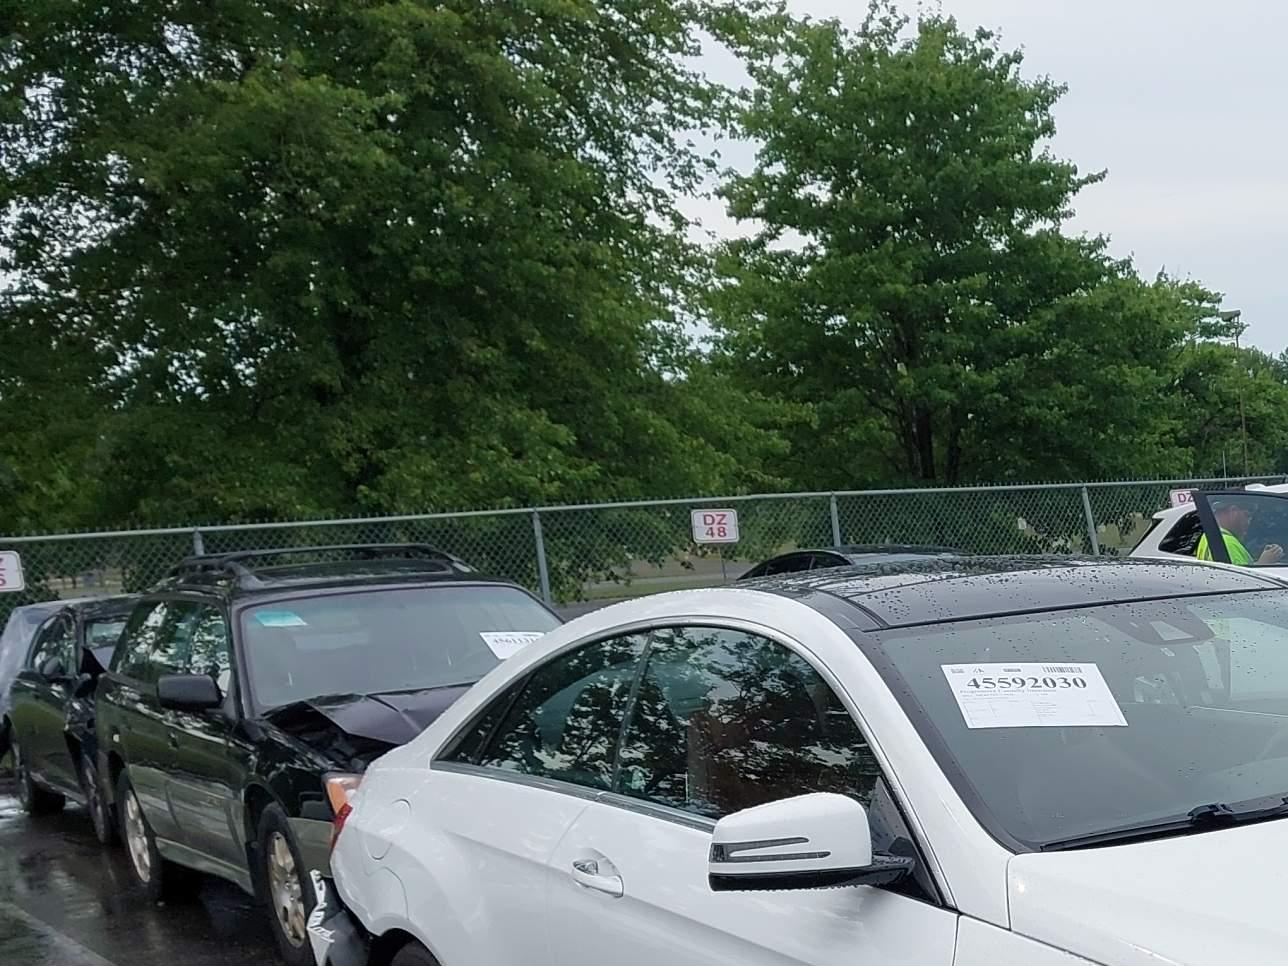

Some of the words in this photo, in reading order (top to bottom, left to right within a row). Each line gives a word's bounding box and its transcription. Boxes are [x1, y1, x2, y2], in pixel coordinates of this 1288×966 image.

[703, 514, 727, 525] DZ
[705, 527, 727, 538] 48
[966, 676, 1087, 689] 45592030
